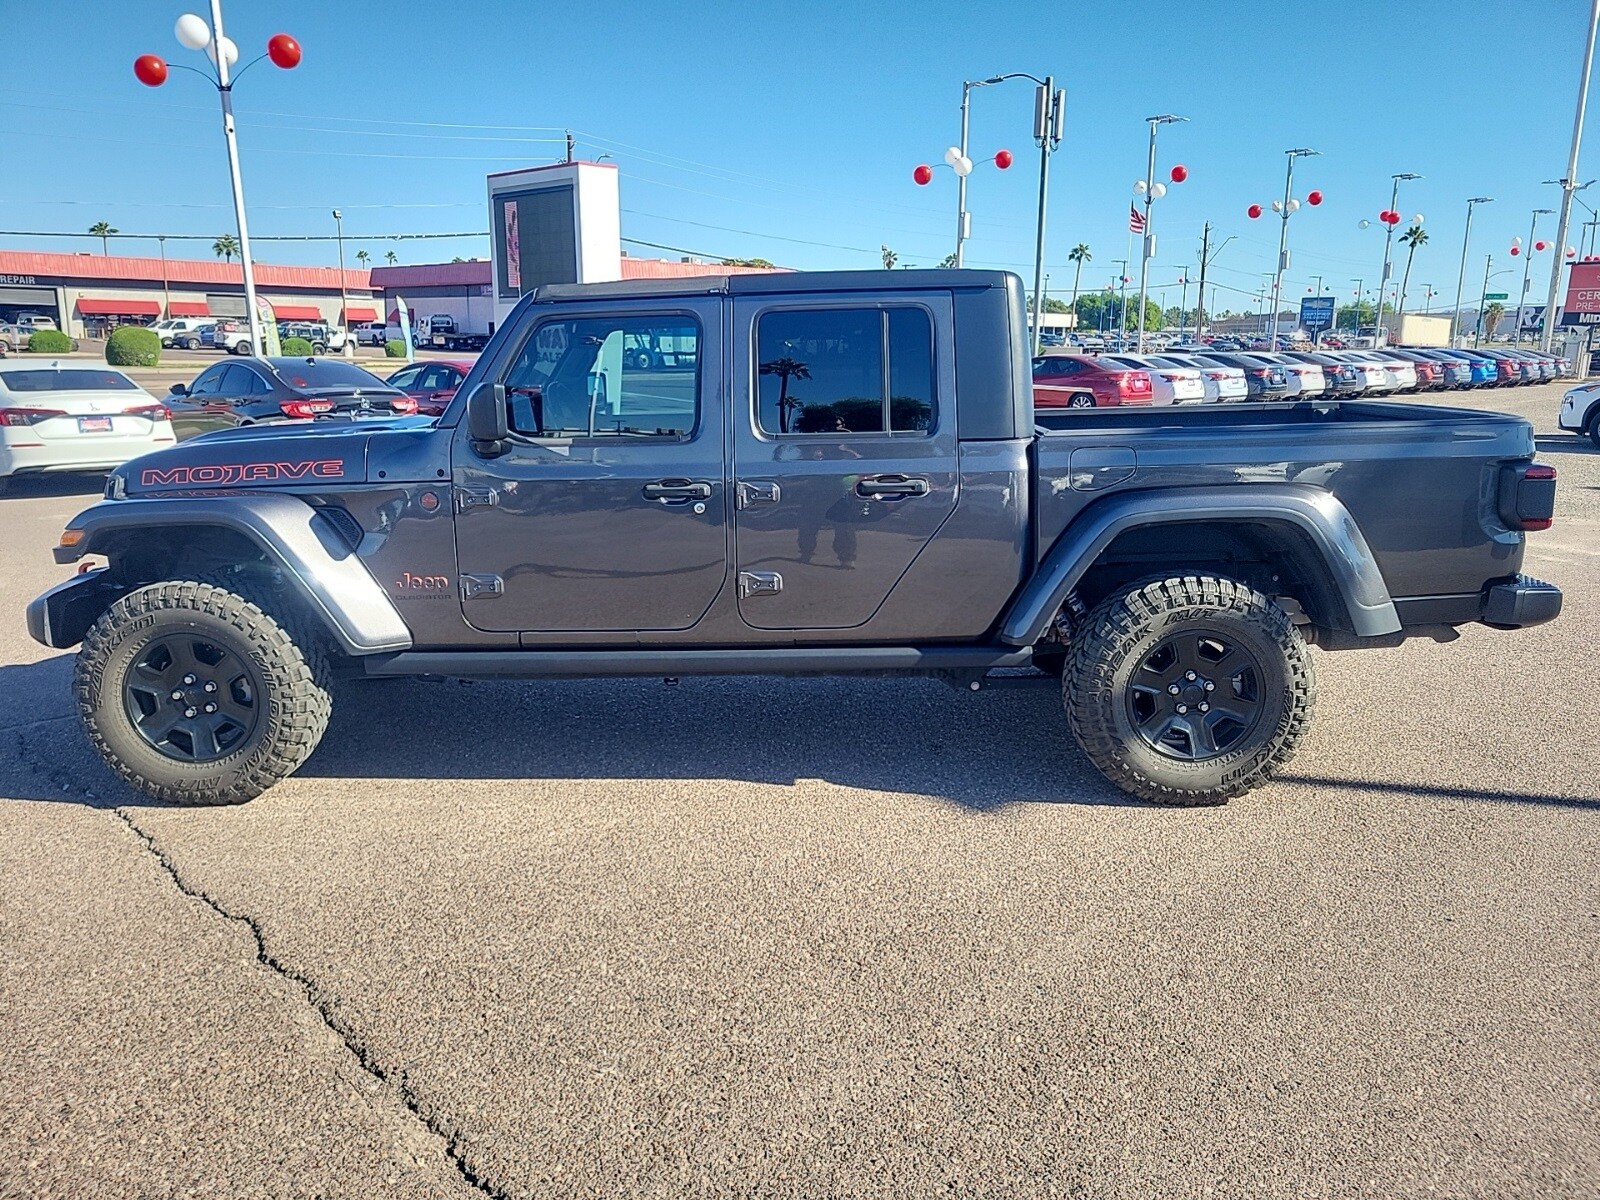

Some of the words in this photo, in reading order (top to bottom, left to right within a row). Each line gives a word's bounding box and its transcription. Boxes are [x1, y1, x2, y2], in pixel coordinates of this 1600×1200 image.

[0, 275, 36, 285] REPAIR
[1576, 302, 1600, 310] PRE-
[142, 461, 344, 485] MOJAVE
[396, 572, 449, 592] Jeep
